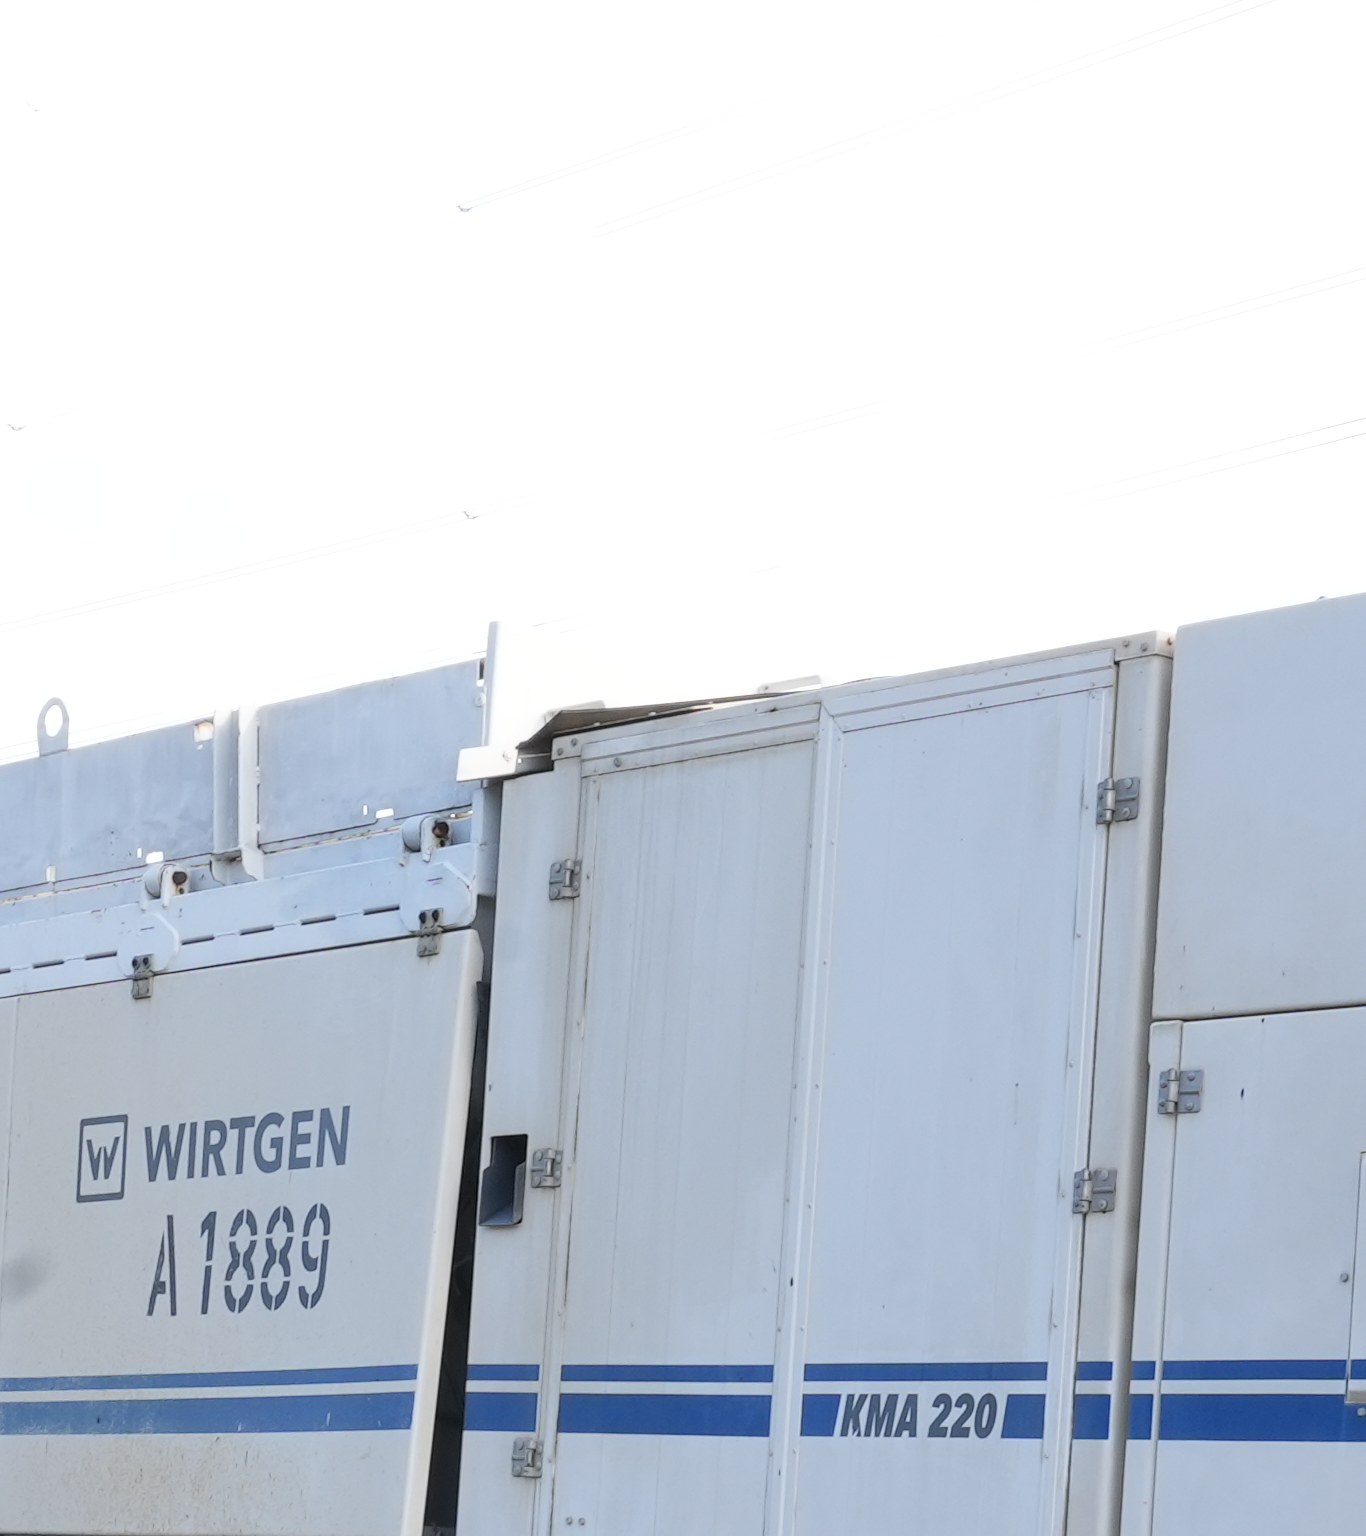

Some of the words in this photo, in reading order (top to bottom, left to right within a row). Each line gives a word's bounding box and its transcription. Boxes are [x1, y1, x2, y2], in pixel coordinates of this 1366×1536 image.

[86, 1136, 120, 1181] W
[144, 1105, 351, 1183] WIRTGEN
[839, 1393, 919, 1438] KMA
[927, 1392, 998, 1439] 220
